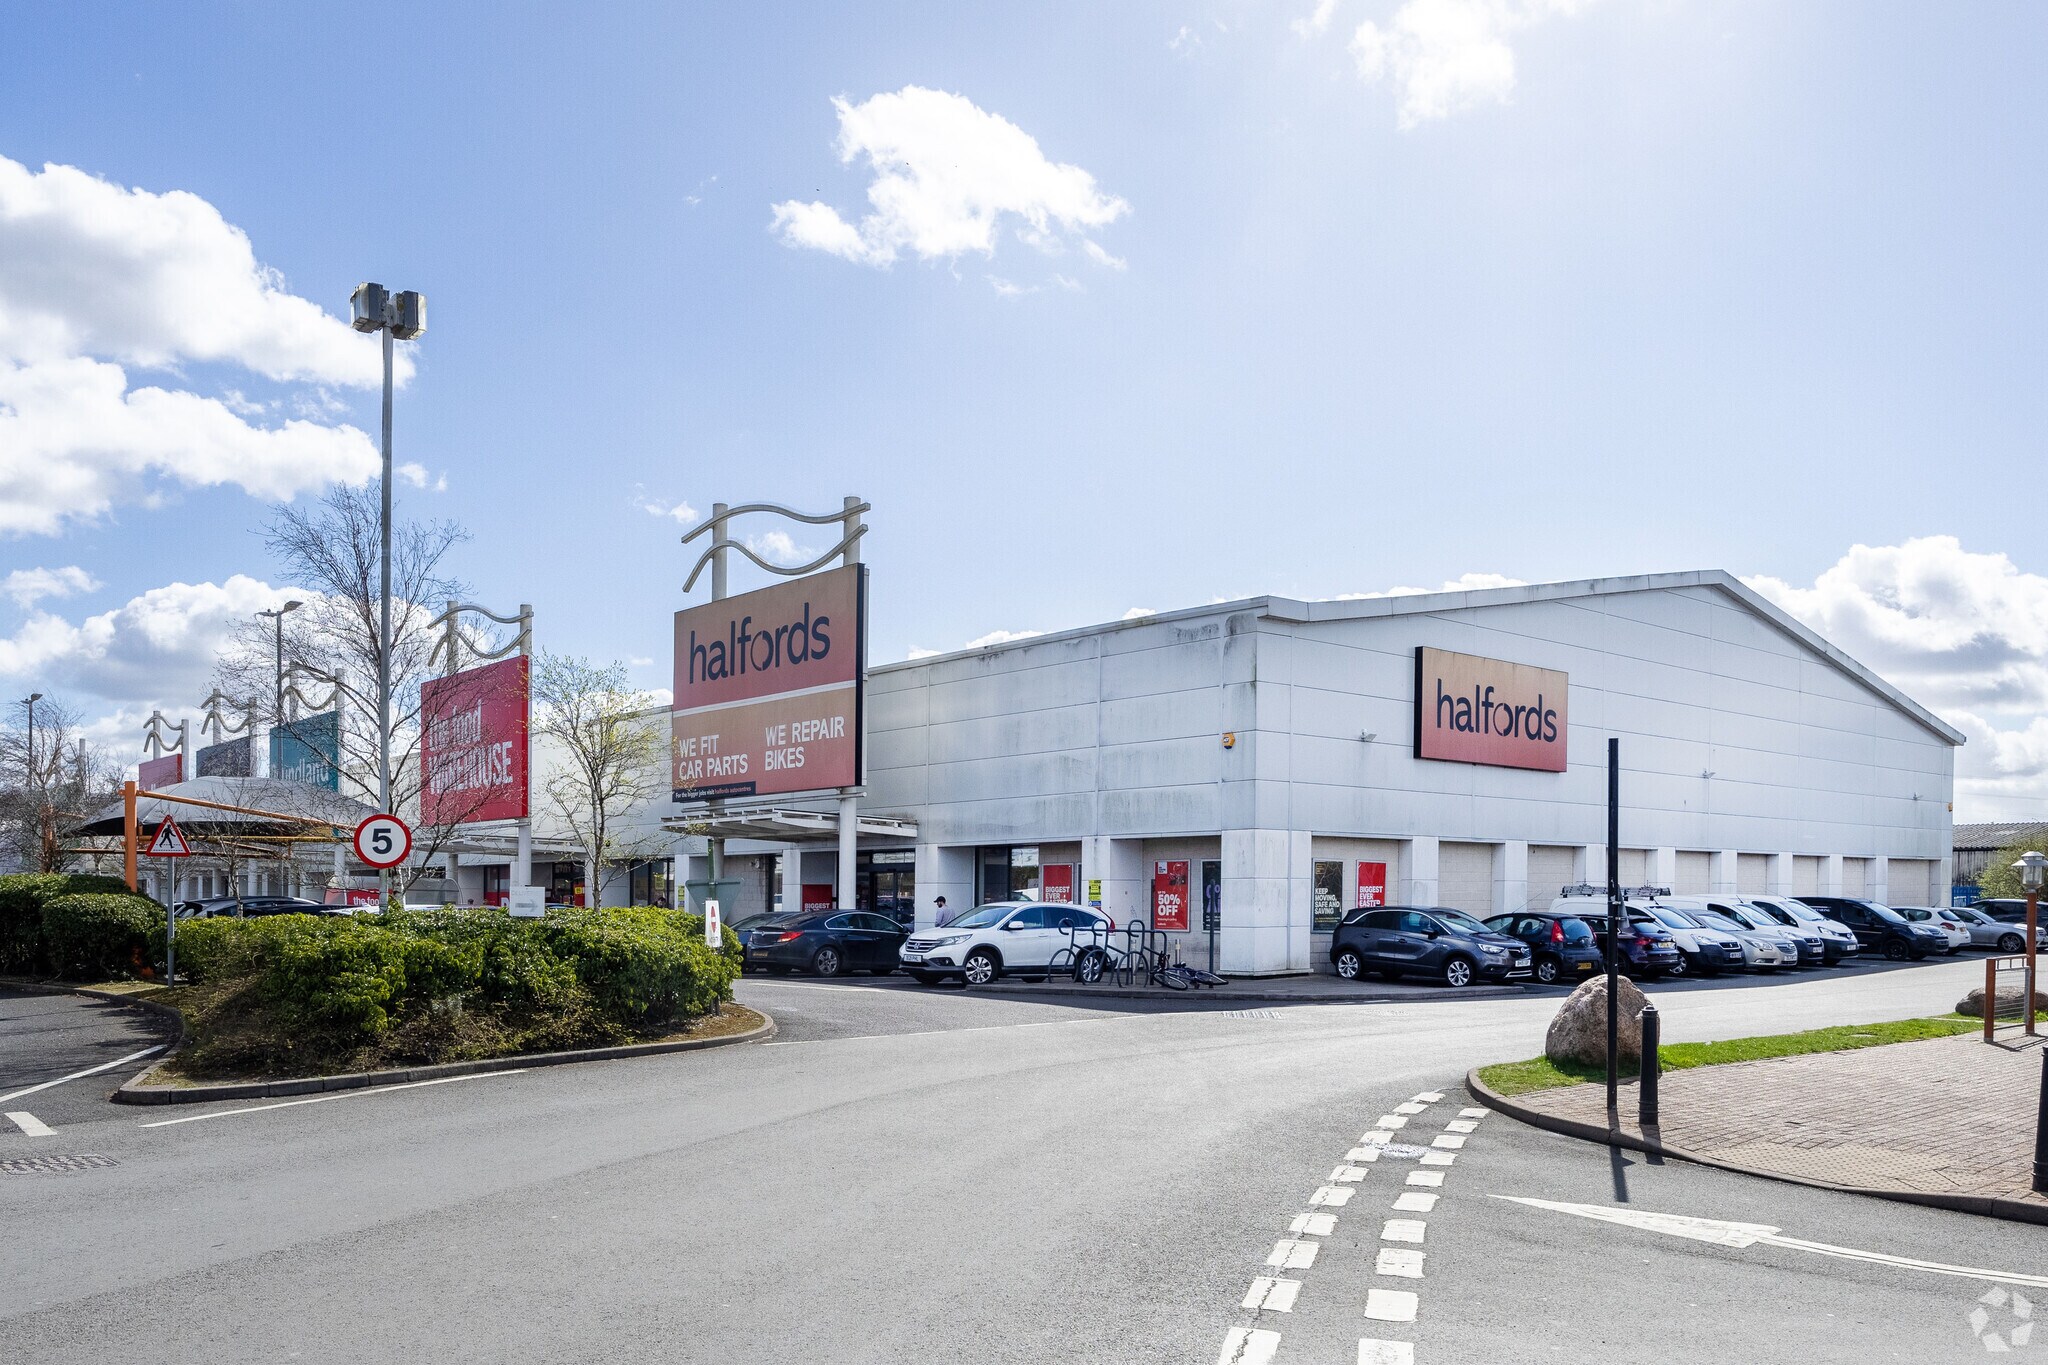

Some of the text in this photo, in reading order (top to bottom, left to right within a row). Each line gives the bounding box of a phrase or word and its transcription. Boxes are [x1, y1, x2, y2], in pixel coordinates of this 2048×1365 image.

[689, 602, 831, 684] halfords
[452, 699, 482, 745] food
[1437, 678, 1557, 743] halfords
[765, 716, 845, 747] WE REPAIR
[679, 734, 720, 758] WE FIT
[764, 746, 805, 771] BIKES
[428, 741, 513, 795] WAREHOUSE
[679, 754, 748, 780] CAR PARTS
[706, 788, 715, 796] visit
[371, 828, 393, 854] 5
[353, 896, 380, 906] the foo
[1158, 894, 1180, 905] 50%
[1158, 905, 1178, 915] OFF
